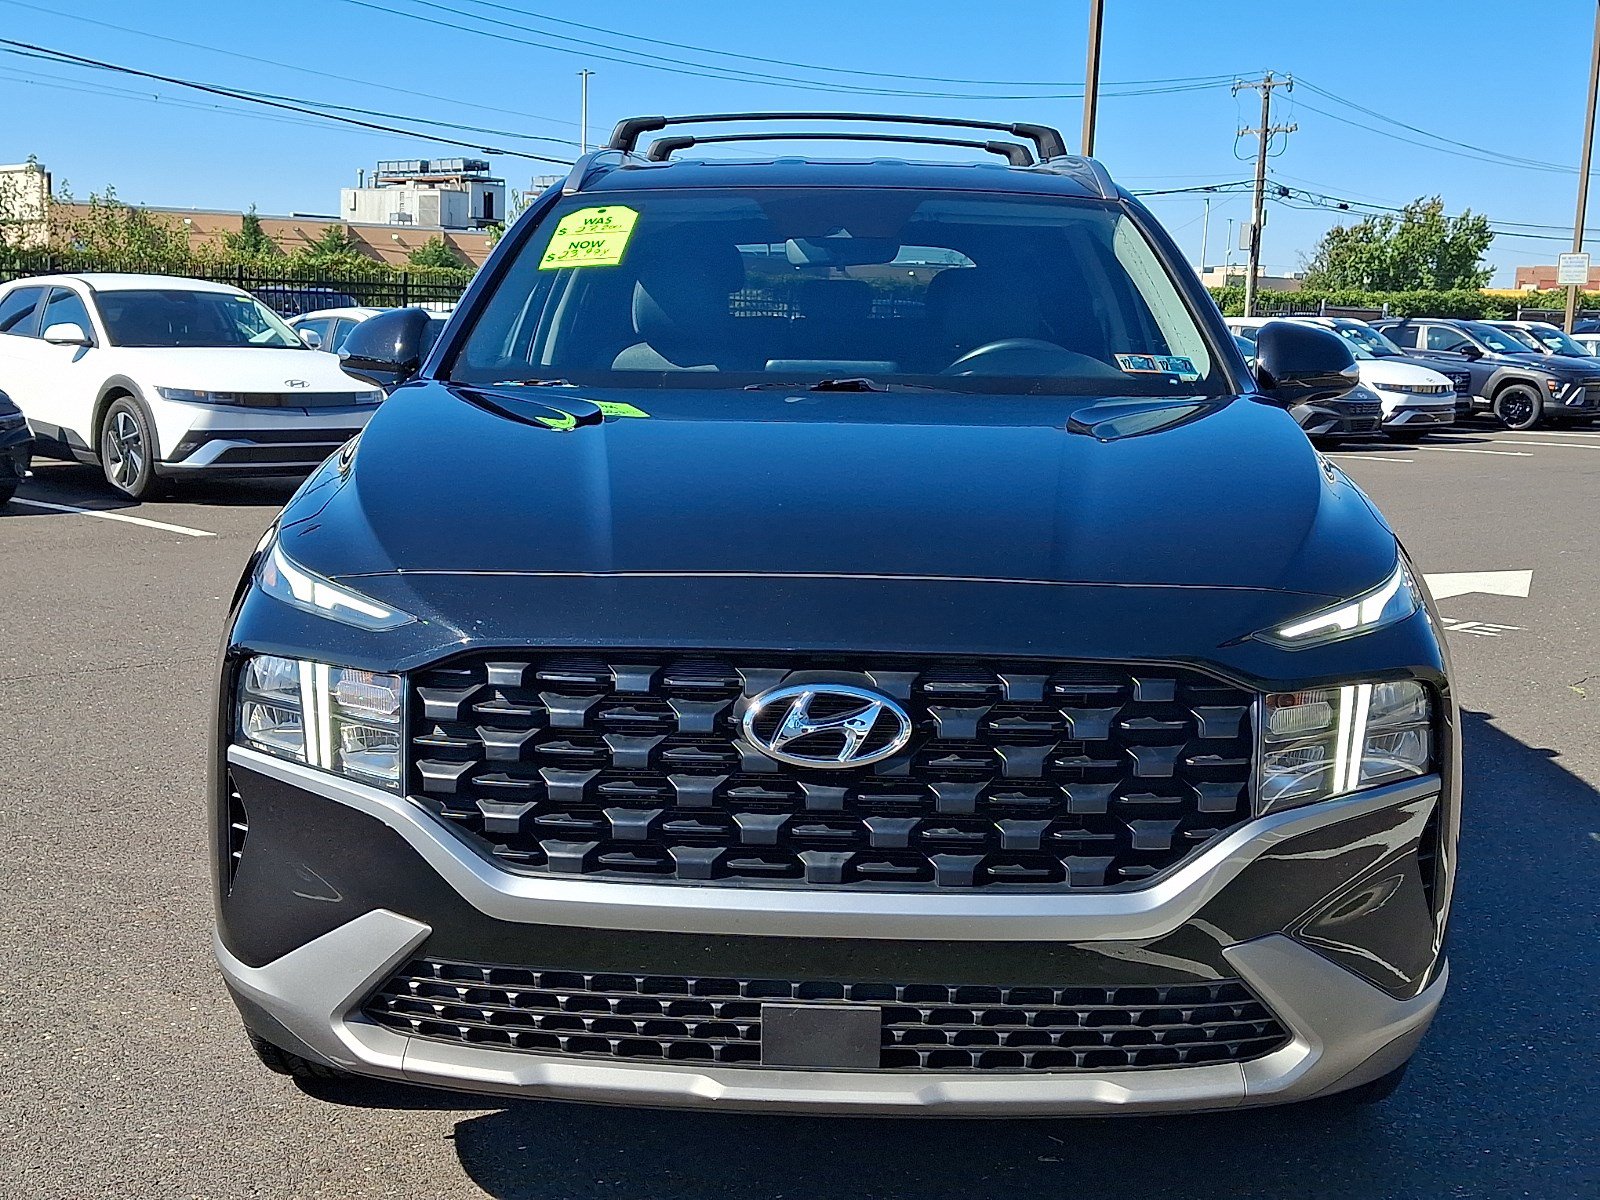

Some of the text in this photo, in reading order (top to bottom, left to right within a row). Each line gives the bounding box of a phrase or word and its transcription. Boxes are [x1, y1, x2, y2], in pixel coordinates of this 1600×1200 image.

[584, 216, 612, 225] WAS
[558, 227, 567, 236] $
[568, 239, 606, 249] NOW
[546, 253, 556, 262] $
